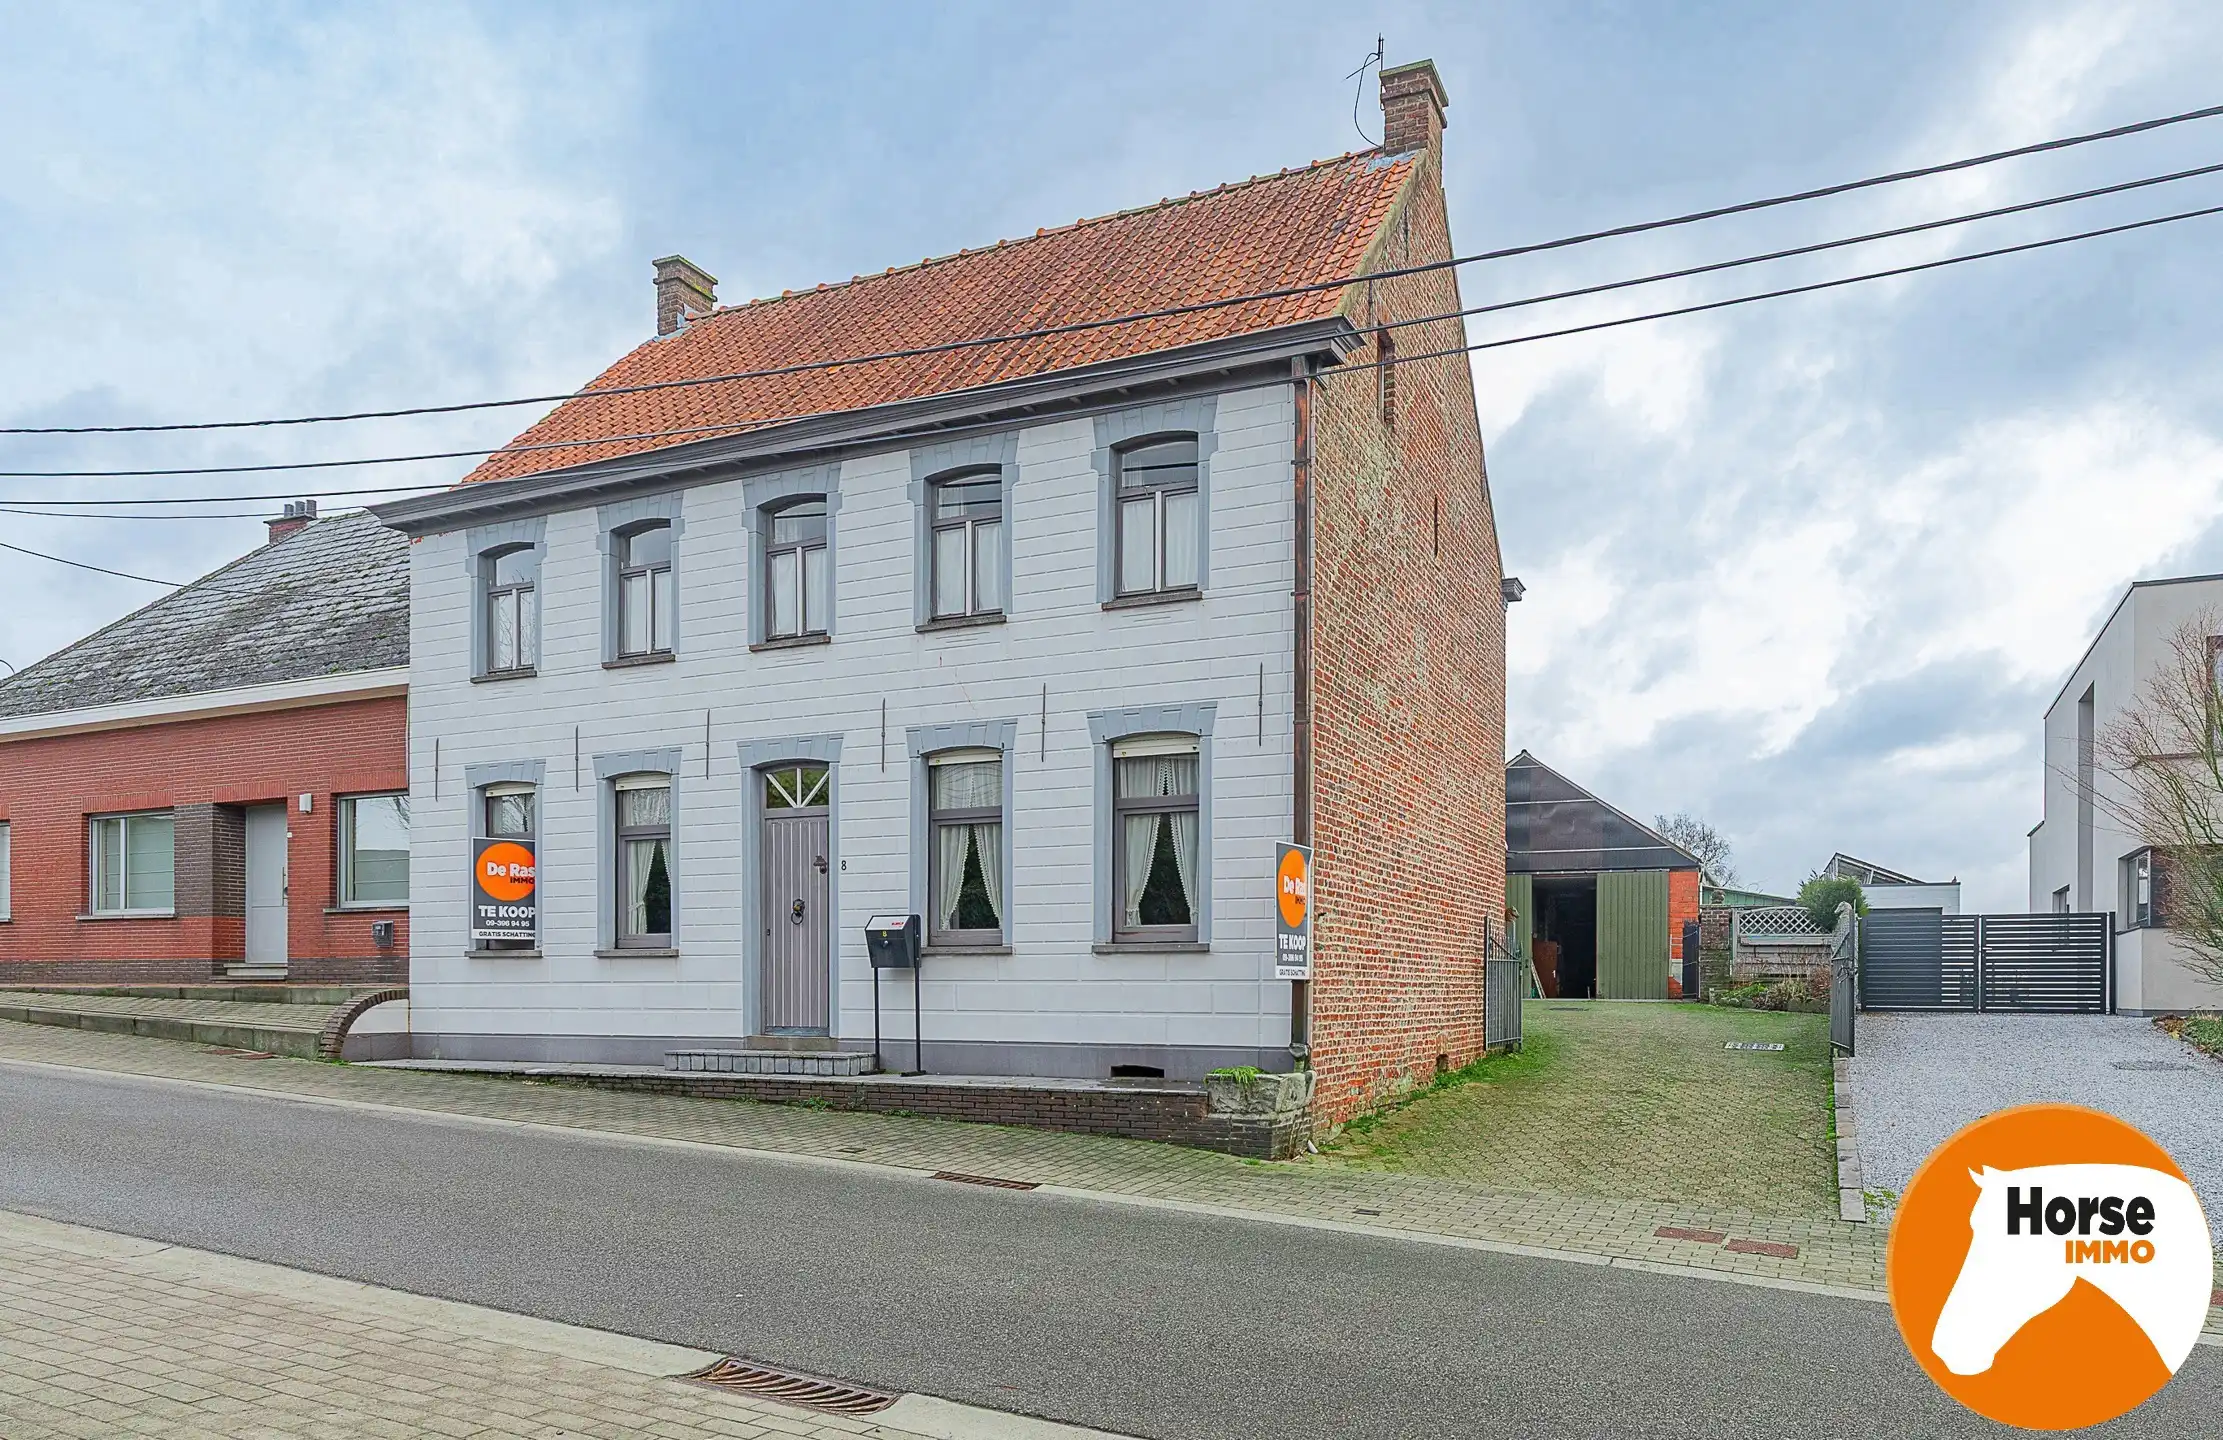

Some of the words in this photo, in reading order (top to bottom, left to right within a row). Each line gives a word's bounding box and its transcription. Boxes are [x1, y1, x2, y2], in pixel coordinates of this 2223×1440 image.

[487, 861, 507, 877] De
[841, 860, 847, 870] 8
[510, 877, 535, 885] IMMO
[1283, 875, 1295, 895] De
[478, 905, 497, 917] TE
[498, 905, 536, 918] KOOP
[1278, 933, 1289, 949] TE
[1289, 934, 1306, 950] KOOP
